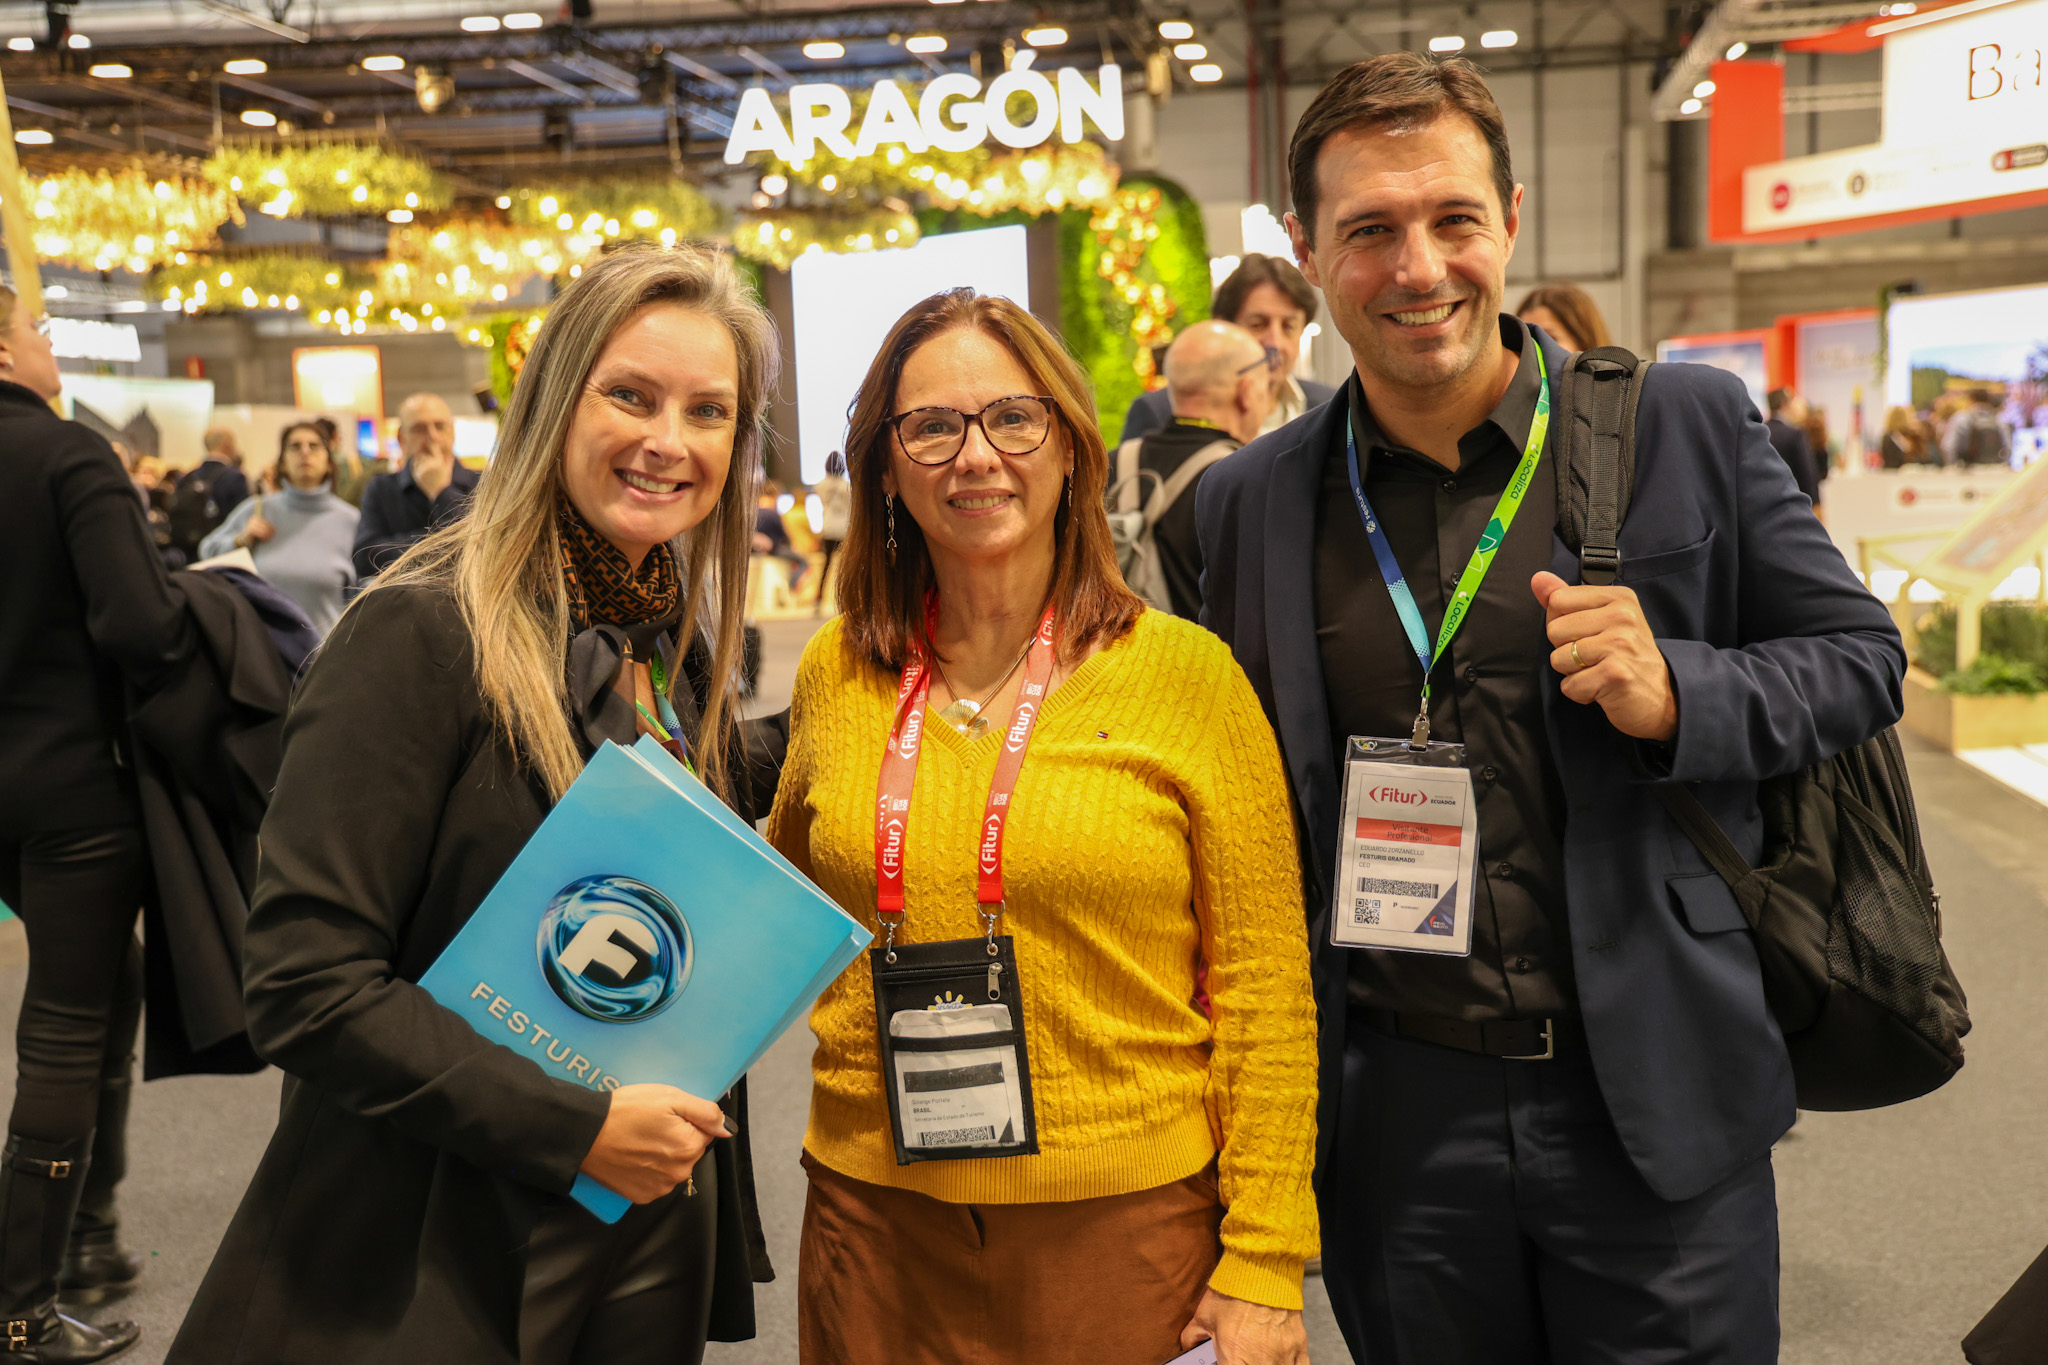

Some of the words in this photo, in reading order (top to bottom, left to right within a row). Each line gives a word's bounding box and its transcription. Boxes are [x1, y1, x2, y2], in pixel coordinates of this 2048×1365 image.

[723, 49, 1125, 165] ARAGÓN
[901, 719, 920, 750] Fitur
[1009, 710, 1031, 743] Fitur
[1381, 787, 1418, 804] Fitur
[981, 823, 999, 862] Fitur
[1387, 832, 1432, 842] Profesional
[1392, 824, 1429, 834] Visitante
[883, 828, 901, 867] Fitur
[1359, 853, 1387, 861] FESTURIS
[1360, 845, 1388, 853] EDUARDO
[1388, 848, 1425, 856] ZORZANELLO
[470, 981, 622, 1092] FESTURIS
